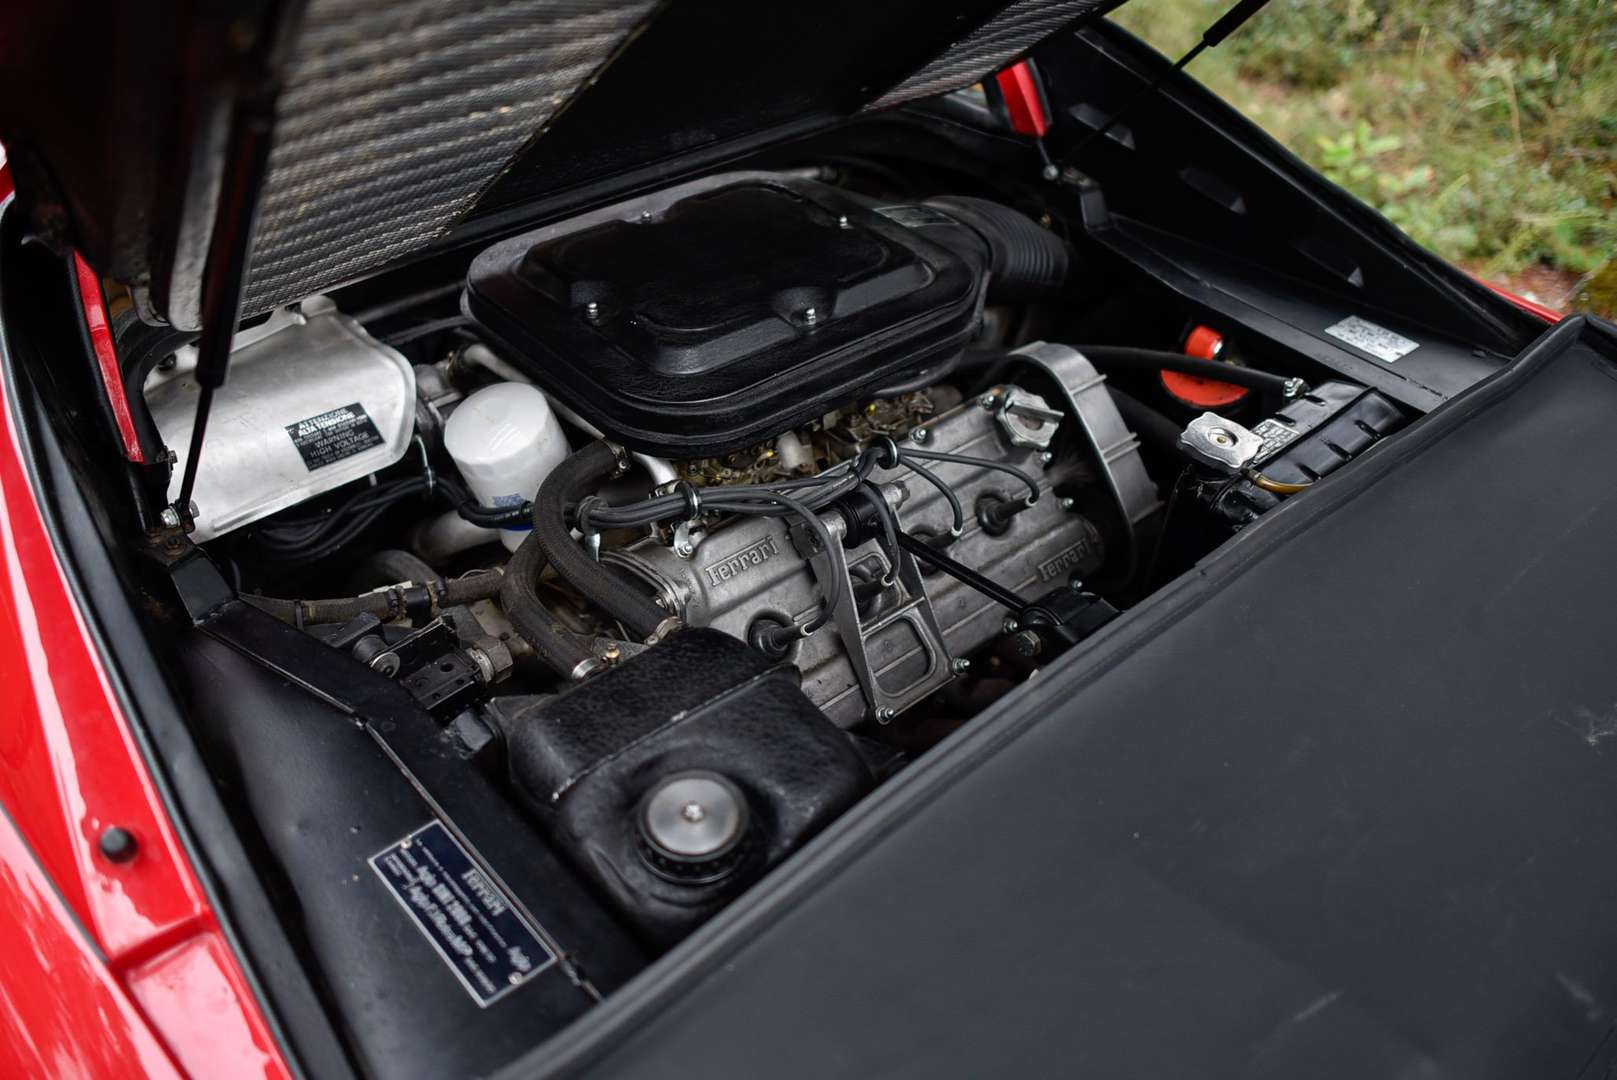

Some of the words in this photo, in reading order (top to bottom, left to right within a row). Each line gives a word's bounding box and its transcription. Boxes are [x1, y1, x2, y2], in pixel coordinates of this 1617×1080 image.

[310, 446, 332, 456] HIGH
[334, 432, 369, 448] VOLTAGE
[315, 429, 354, 447] WARNING
[704, 535, 778, 587] Ferrari
[1038, 537, 1091, 581] Ferrari
